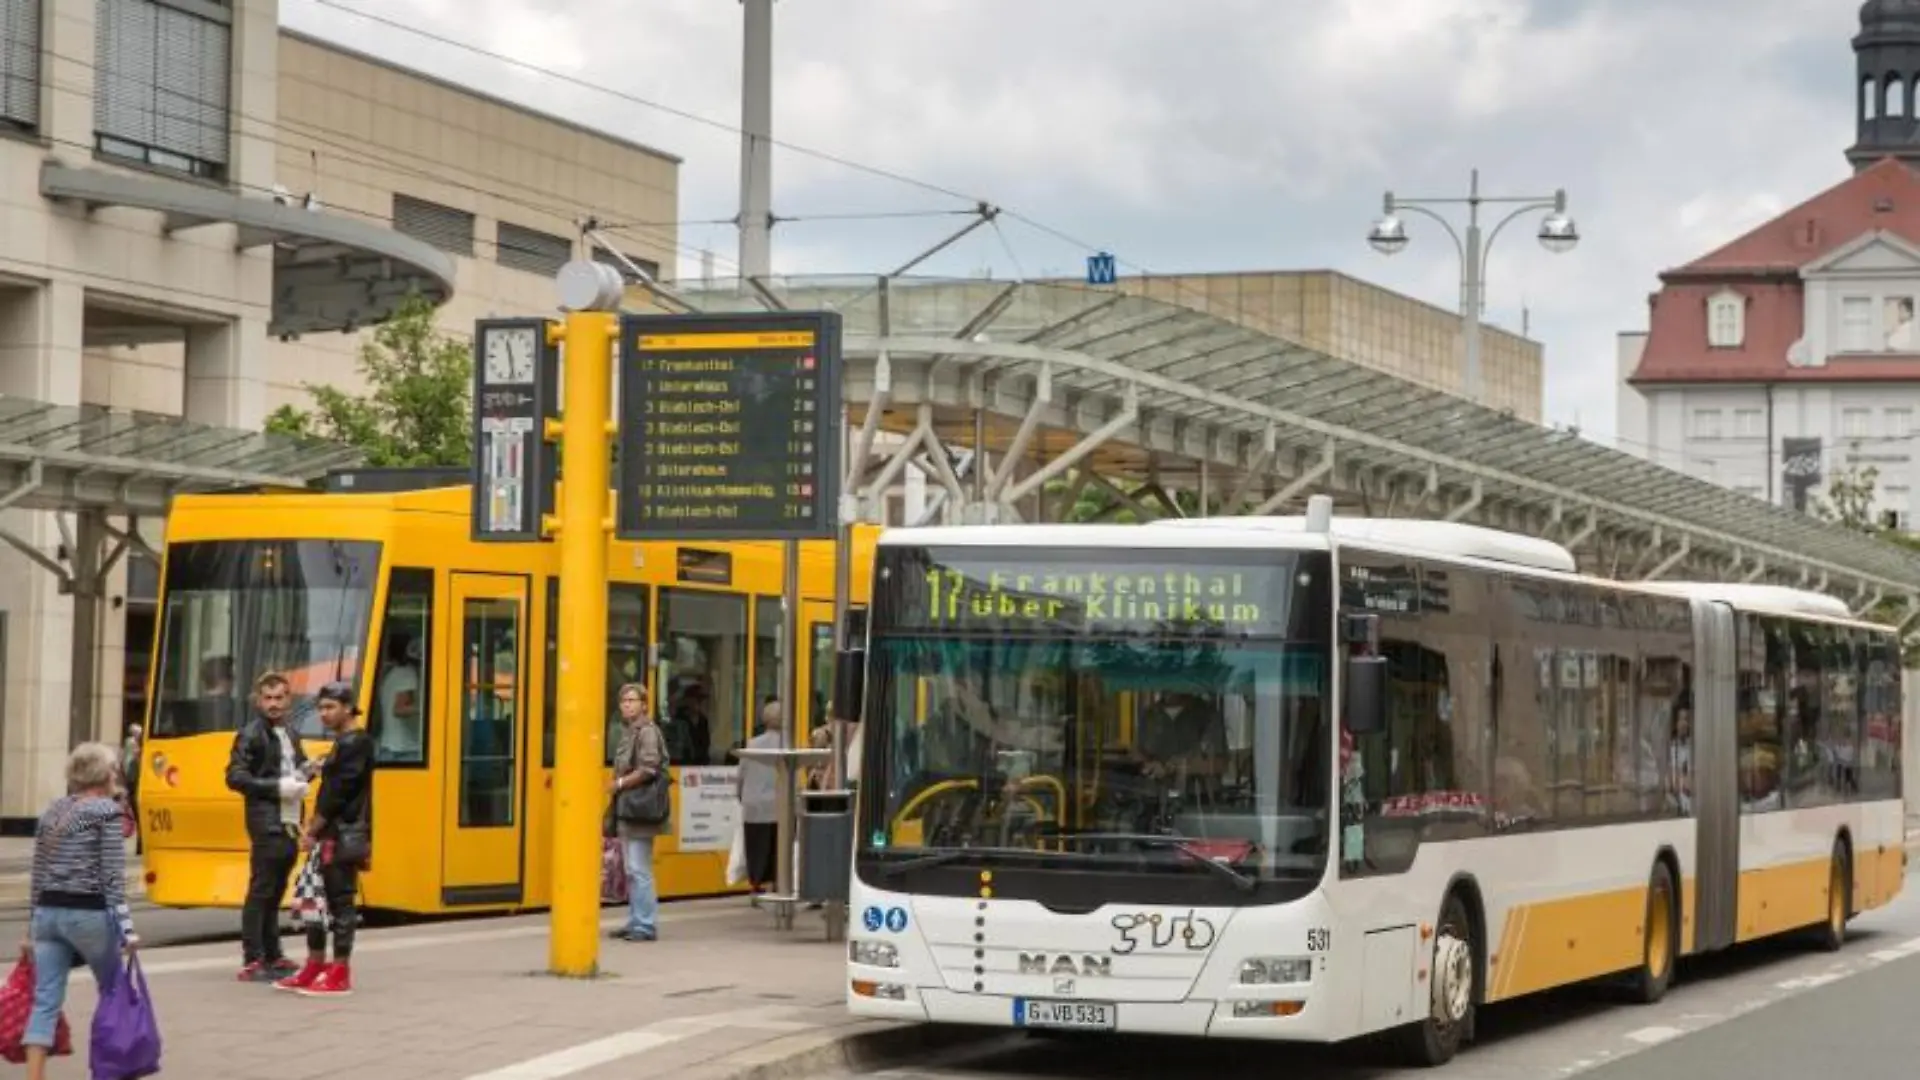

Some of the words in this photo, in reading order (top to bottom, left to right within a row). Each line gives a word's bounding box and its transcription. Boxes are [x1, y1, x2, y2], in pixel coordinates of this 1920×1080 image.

[925, 567, 964, 620] 17
[989, 571, 1242, 596] Frankenthal
[971, 592, 1064, 618] über
[1085, 592, 1260, 621] Klinikum
[1307, 928, 1331, 951] 531
[1018, 952, 1112, 977] MAN
[1077, 1005, 1106, 1024] 531
